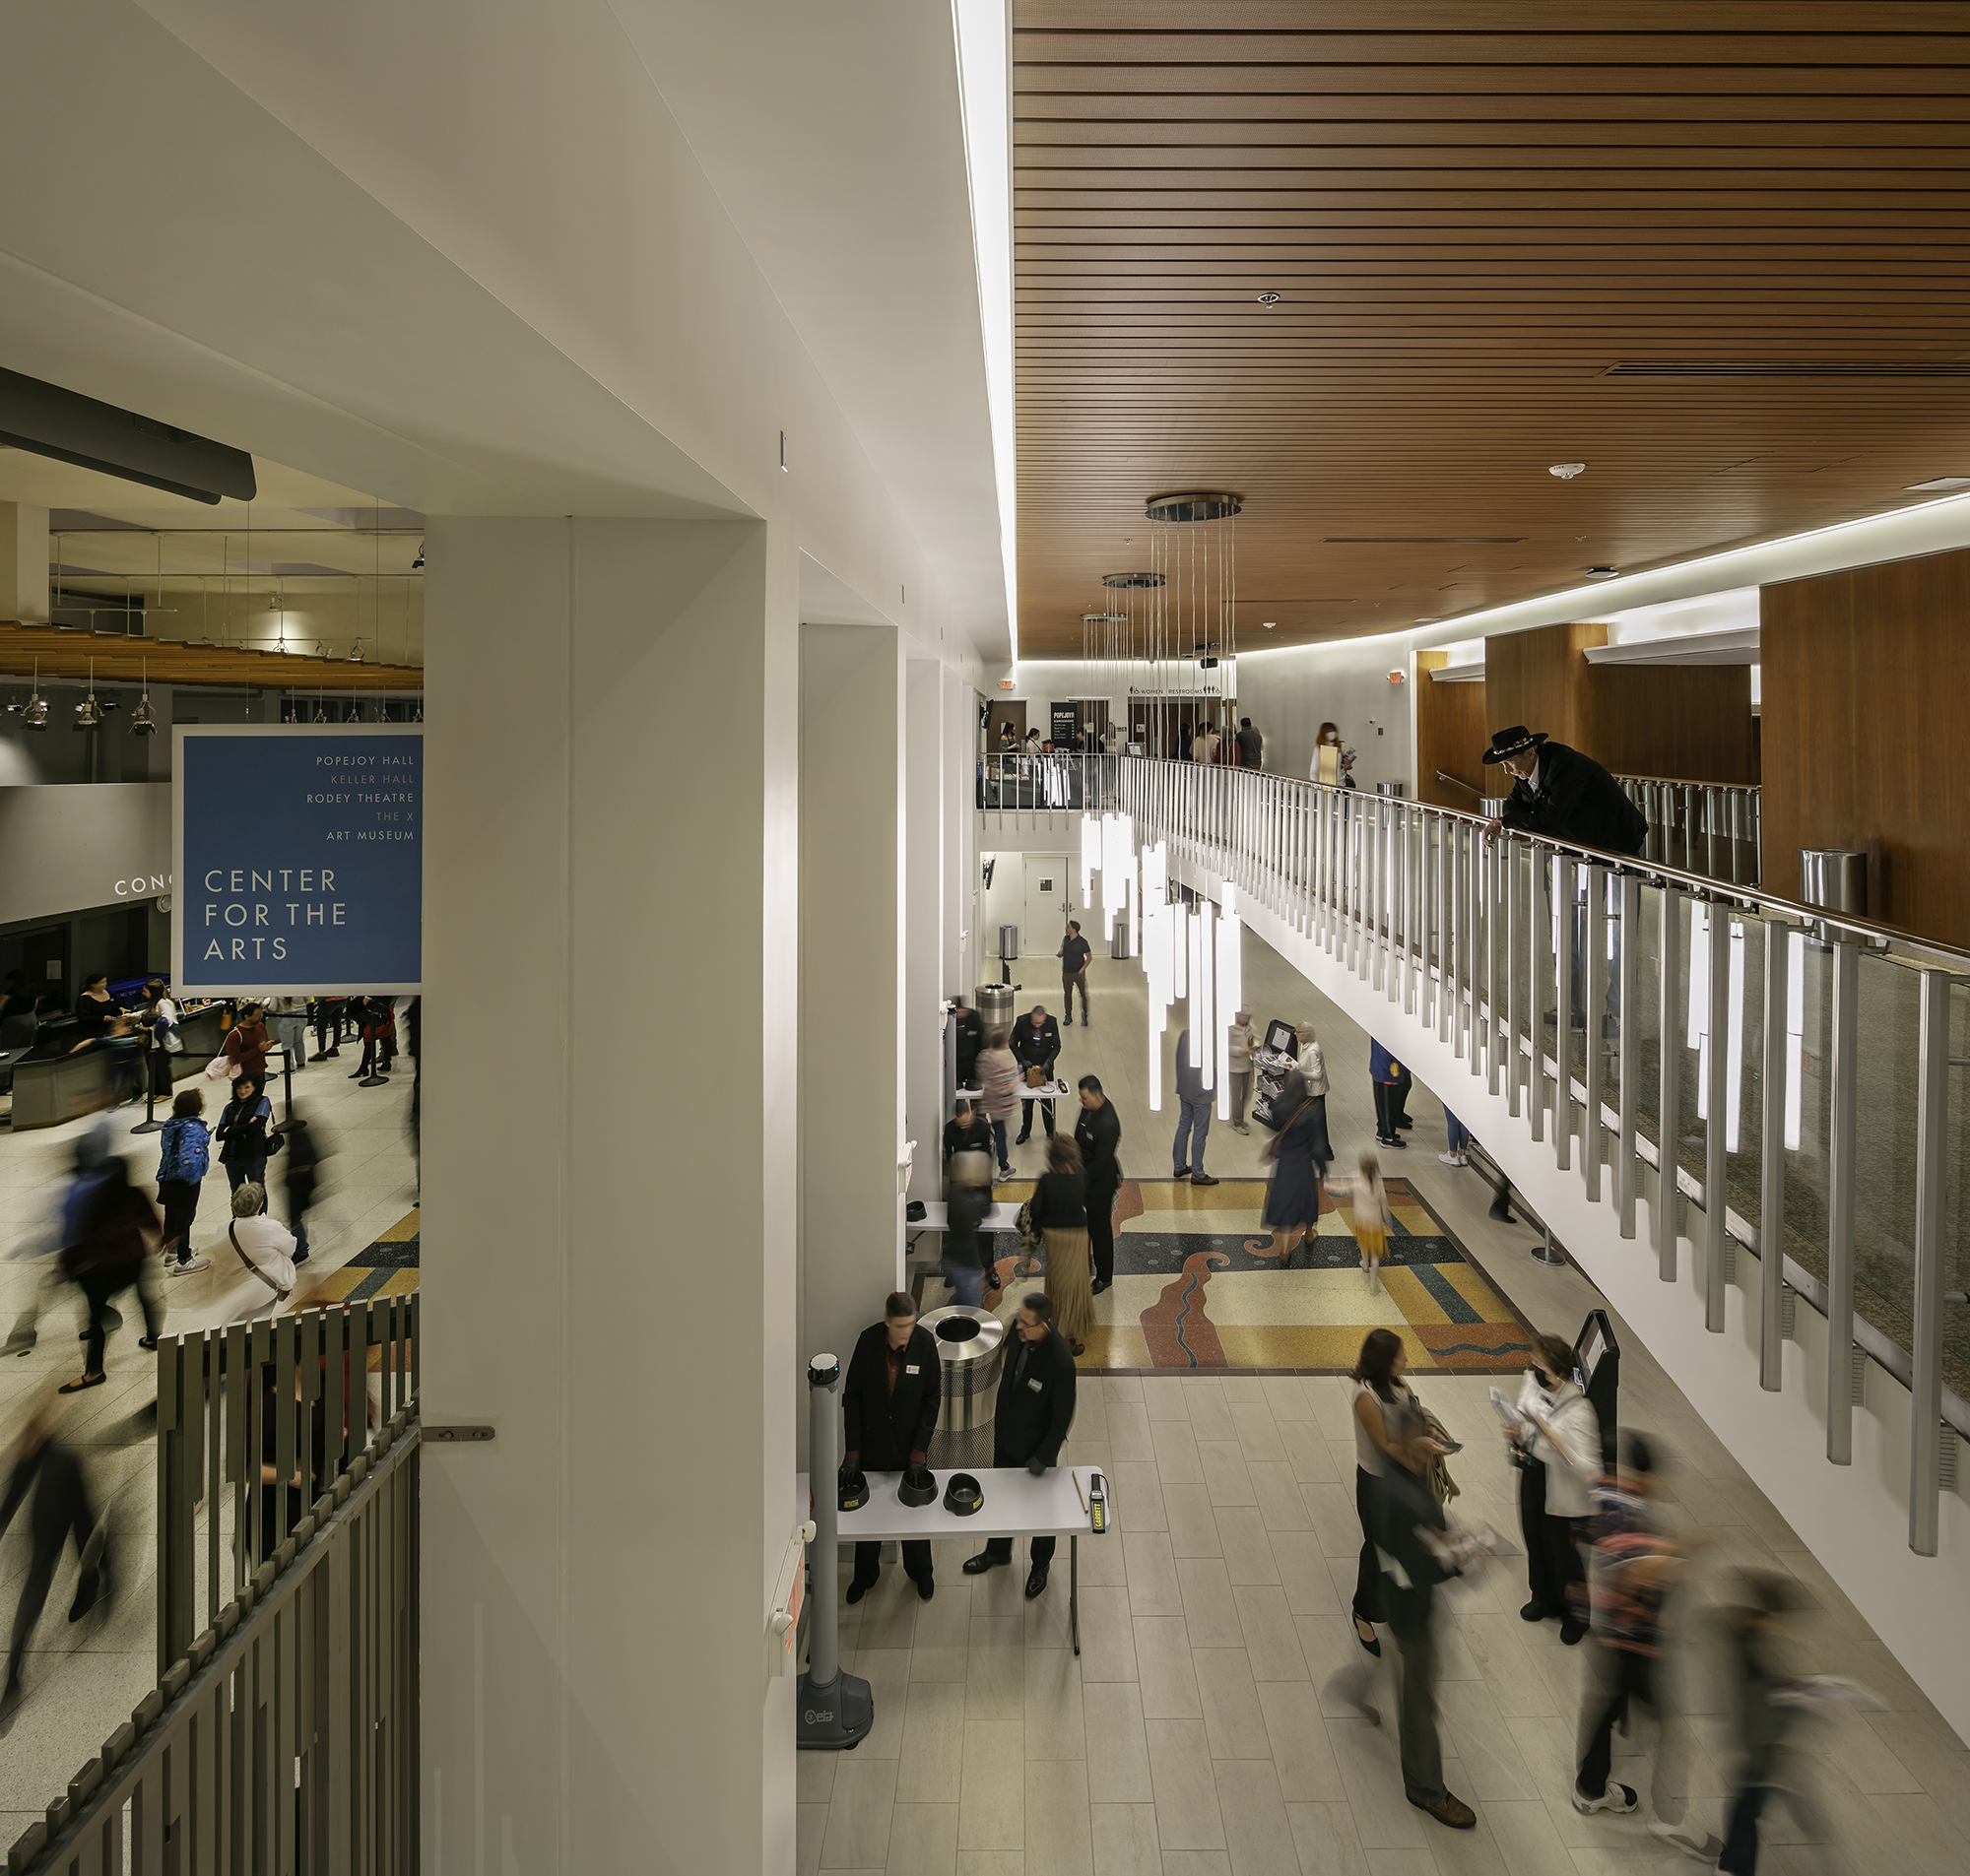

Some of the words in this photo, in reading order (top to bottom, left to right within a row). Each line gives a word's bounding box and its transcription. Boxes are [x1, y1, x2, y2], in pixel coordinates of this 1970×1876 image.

[316, 755, 376, 766] POPEJOY
[382, 755, 414, 765] HALL
[330, 774, 376, 785] KELLER
[382, 774, 414, 784] HALL
[306, 793, 352, 804] RODEY
[358, 793, 414, 803] THEATRE
[376, 811, 399, 821] THE
[406, 811, 414, 821] X
[326, 830, 351, 841] ART
[357, 830, 415, 840] MUSEUM
[114, 873, 172, 896] CON
[204, 870, 336, 892] CENTER
[204, 903, 271, 927] FOR
[285, 903, 346, 926] THE
[203, 937, 288, 961] ARTS
